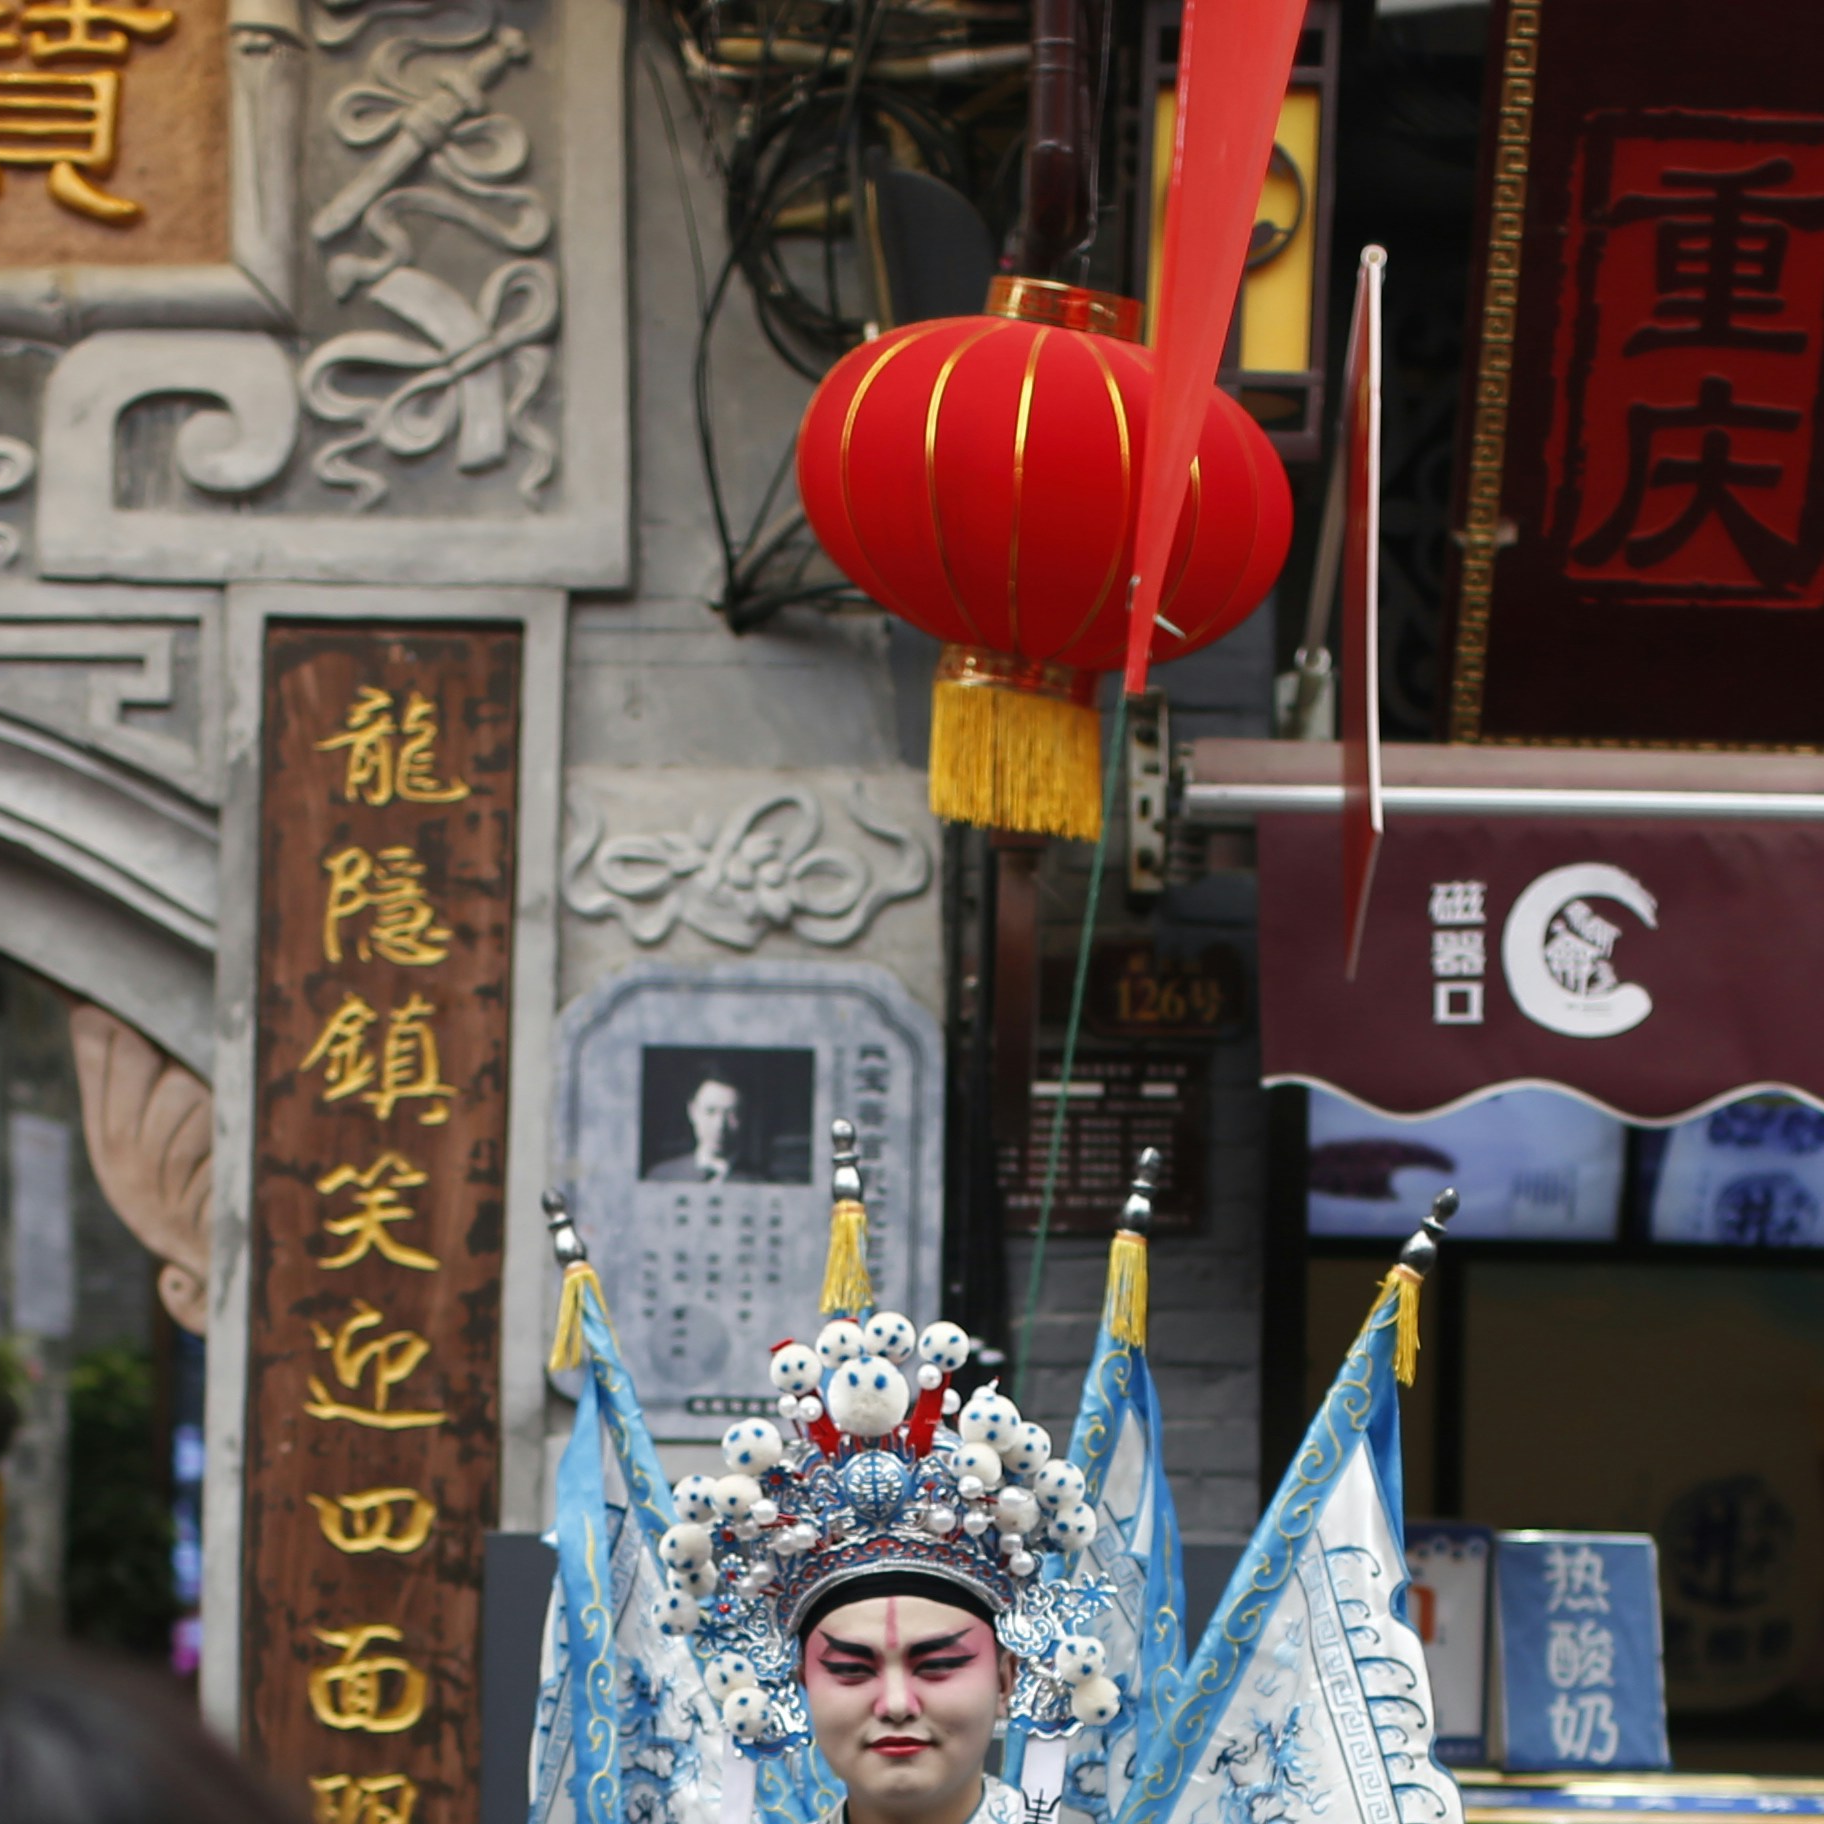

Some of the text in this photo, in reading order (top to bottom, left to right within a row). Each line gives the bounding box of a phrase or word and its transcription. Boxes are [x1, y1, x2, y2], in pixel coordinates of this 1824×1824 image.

[1428, 879, 1487, 1025] 磁器口
[1544, 1545, 1620, 1766] 热酸奶
